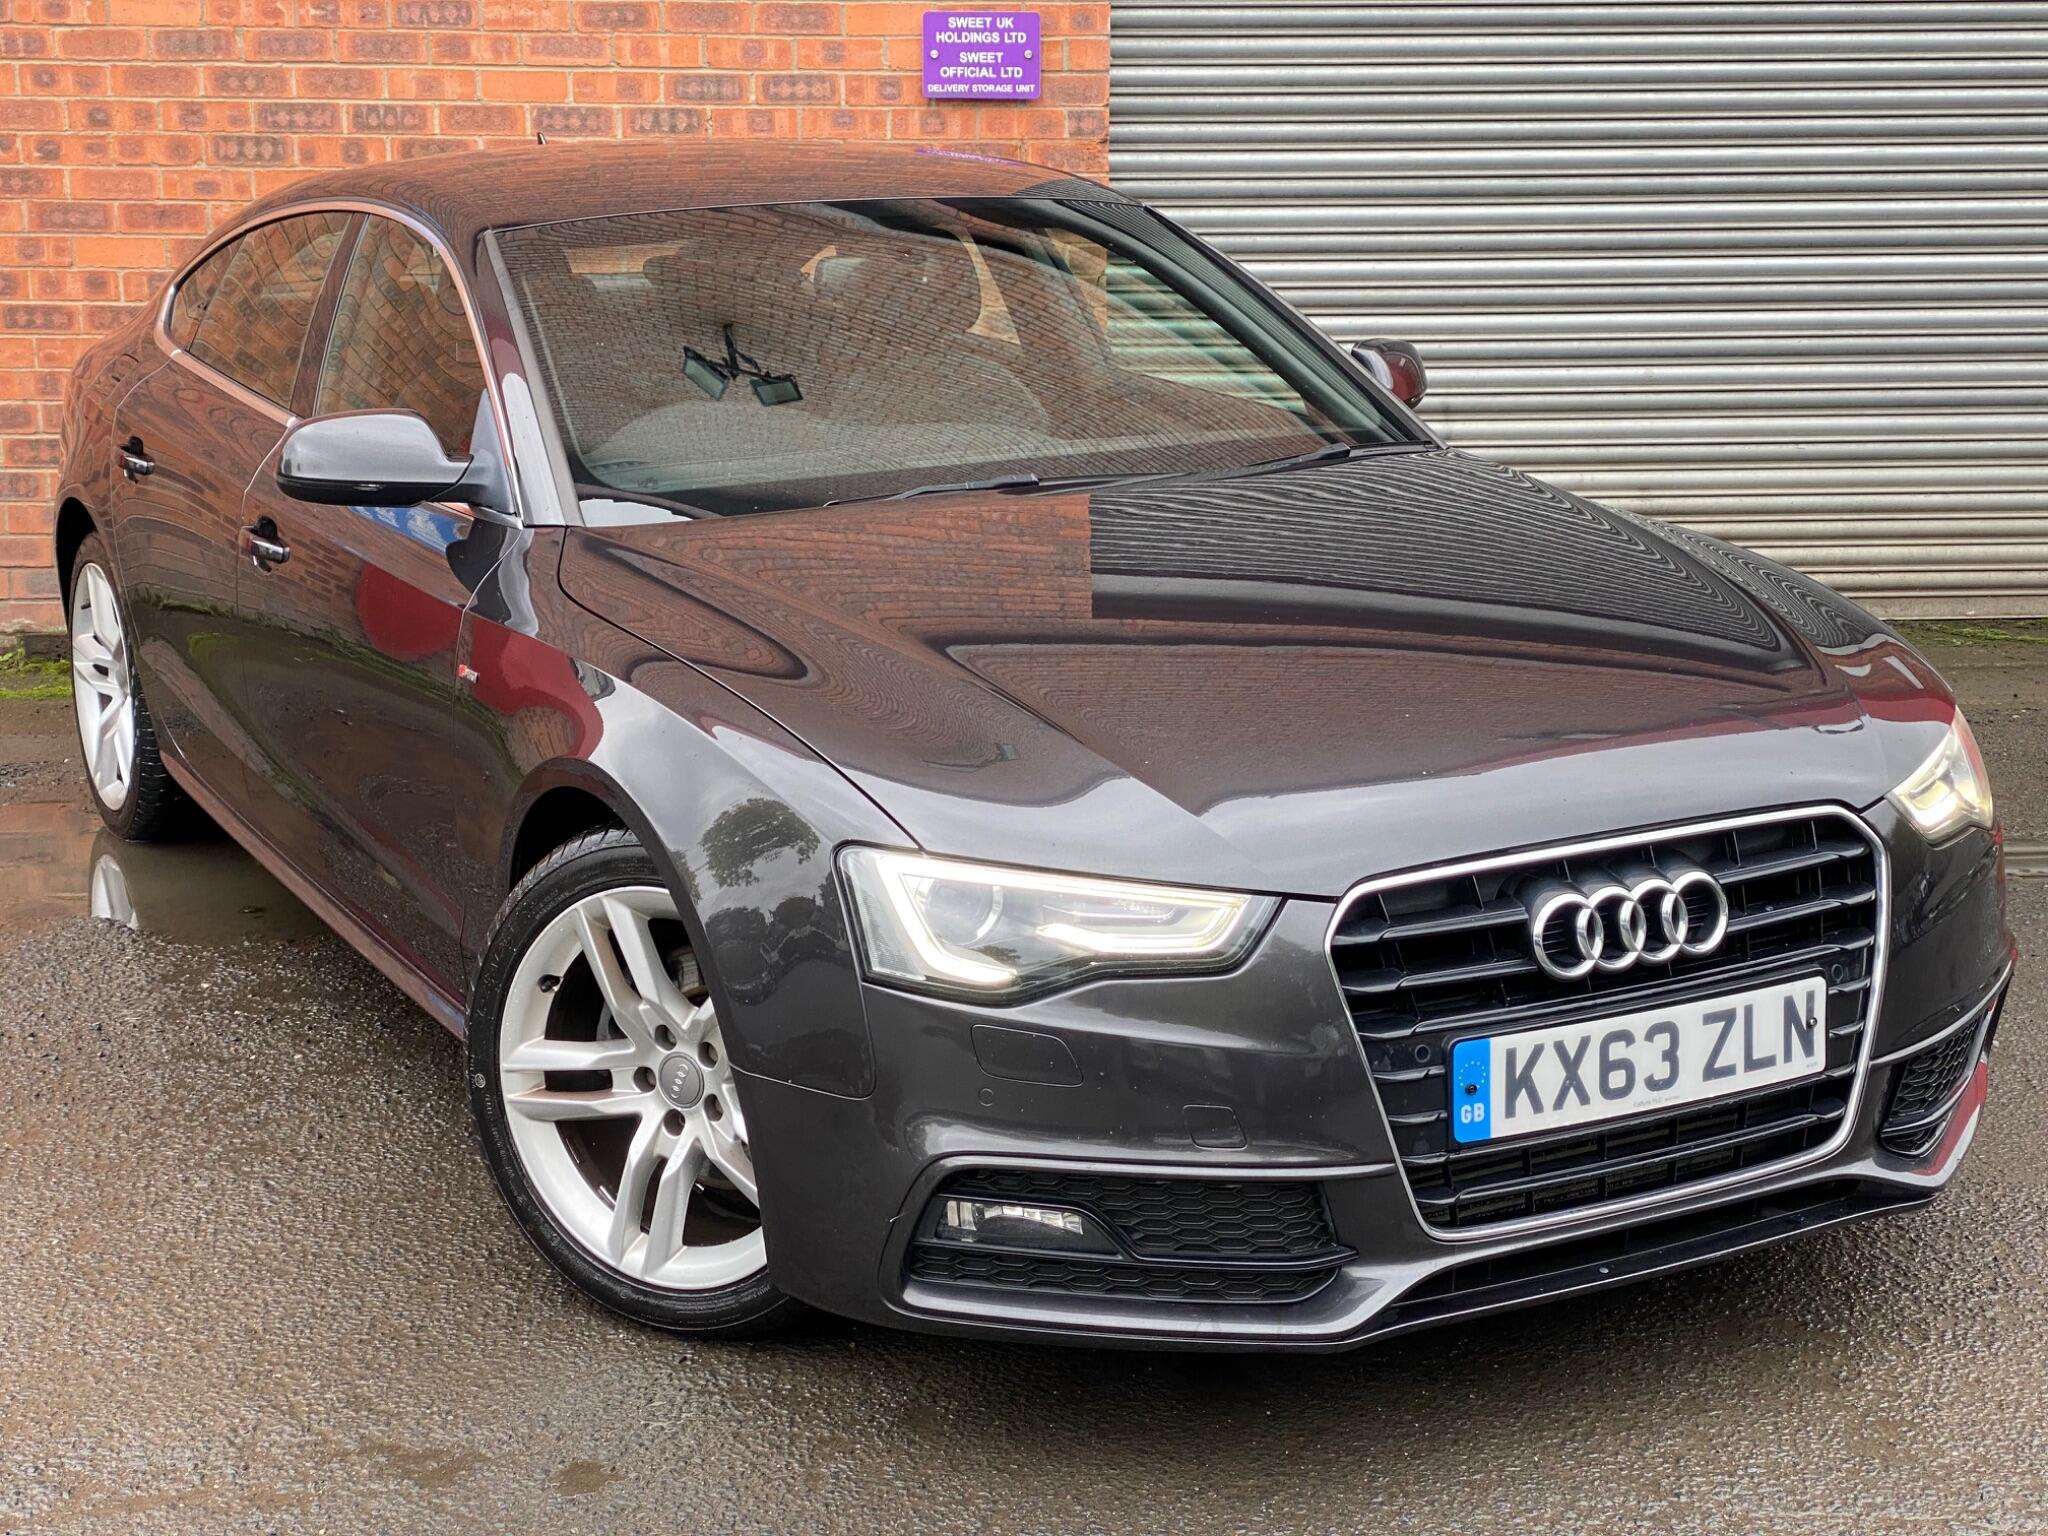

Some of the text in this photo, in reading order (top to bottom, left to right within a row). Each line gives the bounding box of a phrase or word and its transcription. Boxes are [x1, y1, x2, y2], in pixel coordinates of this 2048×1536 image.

[948, 17, 1014, 28] SWEET UK
[936, 32, 1026, 43] HOLDINGS LTD
[959, 52, 1003, 63] SWEET
[940, 67, 1023, 78] OFFICIAL LTD
[928, 84, 1035, 92] DELIVERY STORAGE UNIT
[1505, 990, 1815, 1119] KX63 ZLN
[1460, 1103, 1485, 1125] GB
